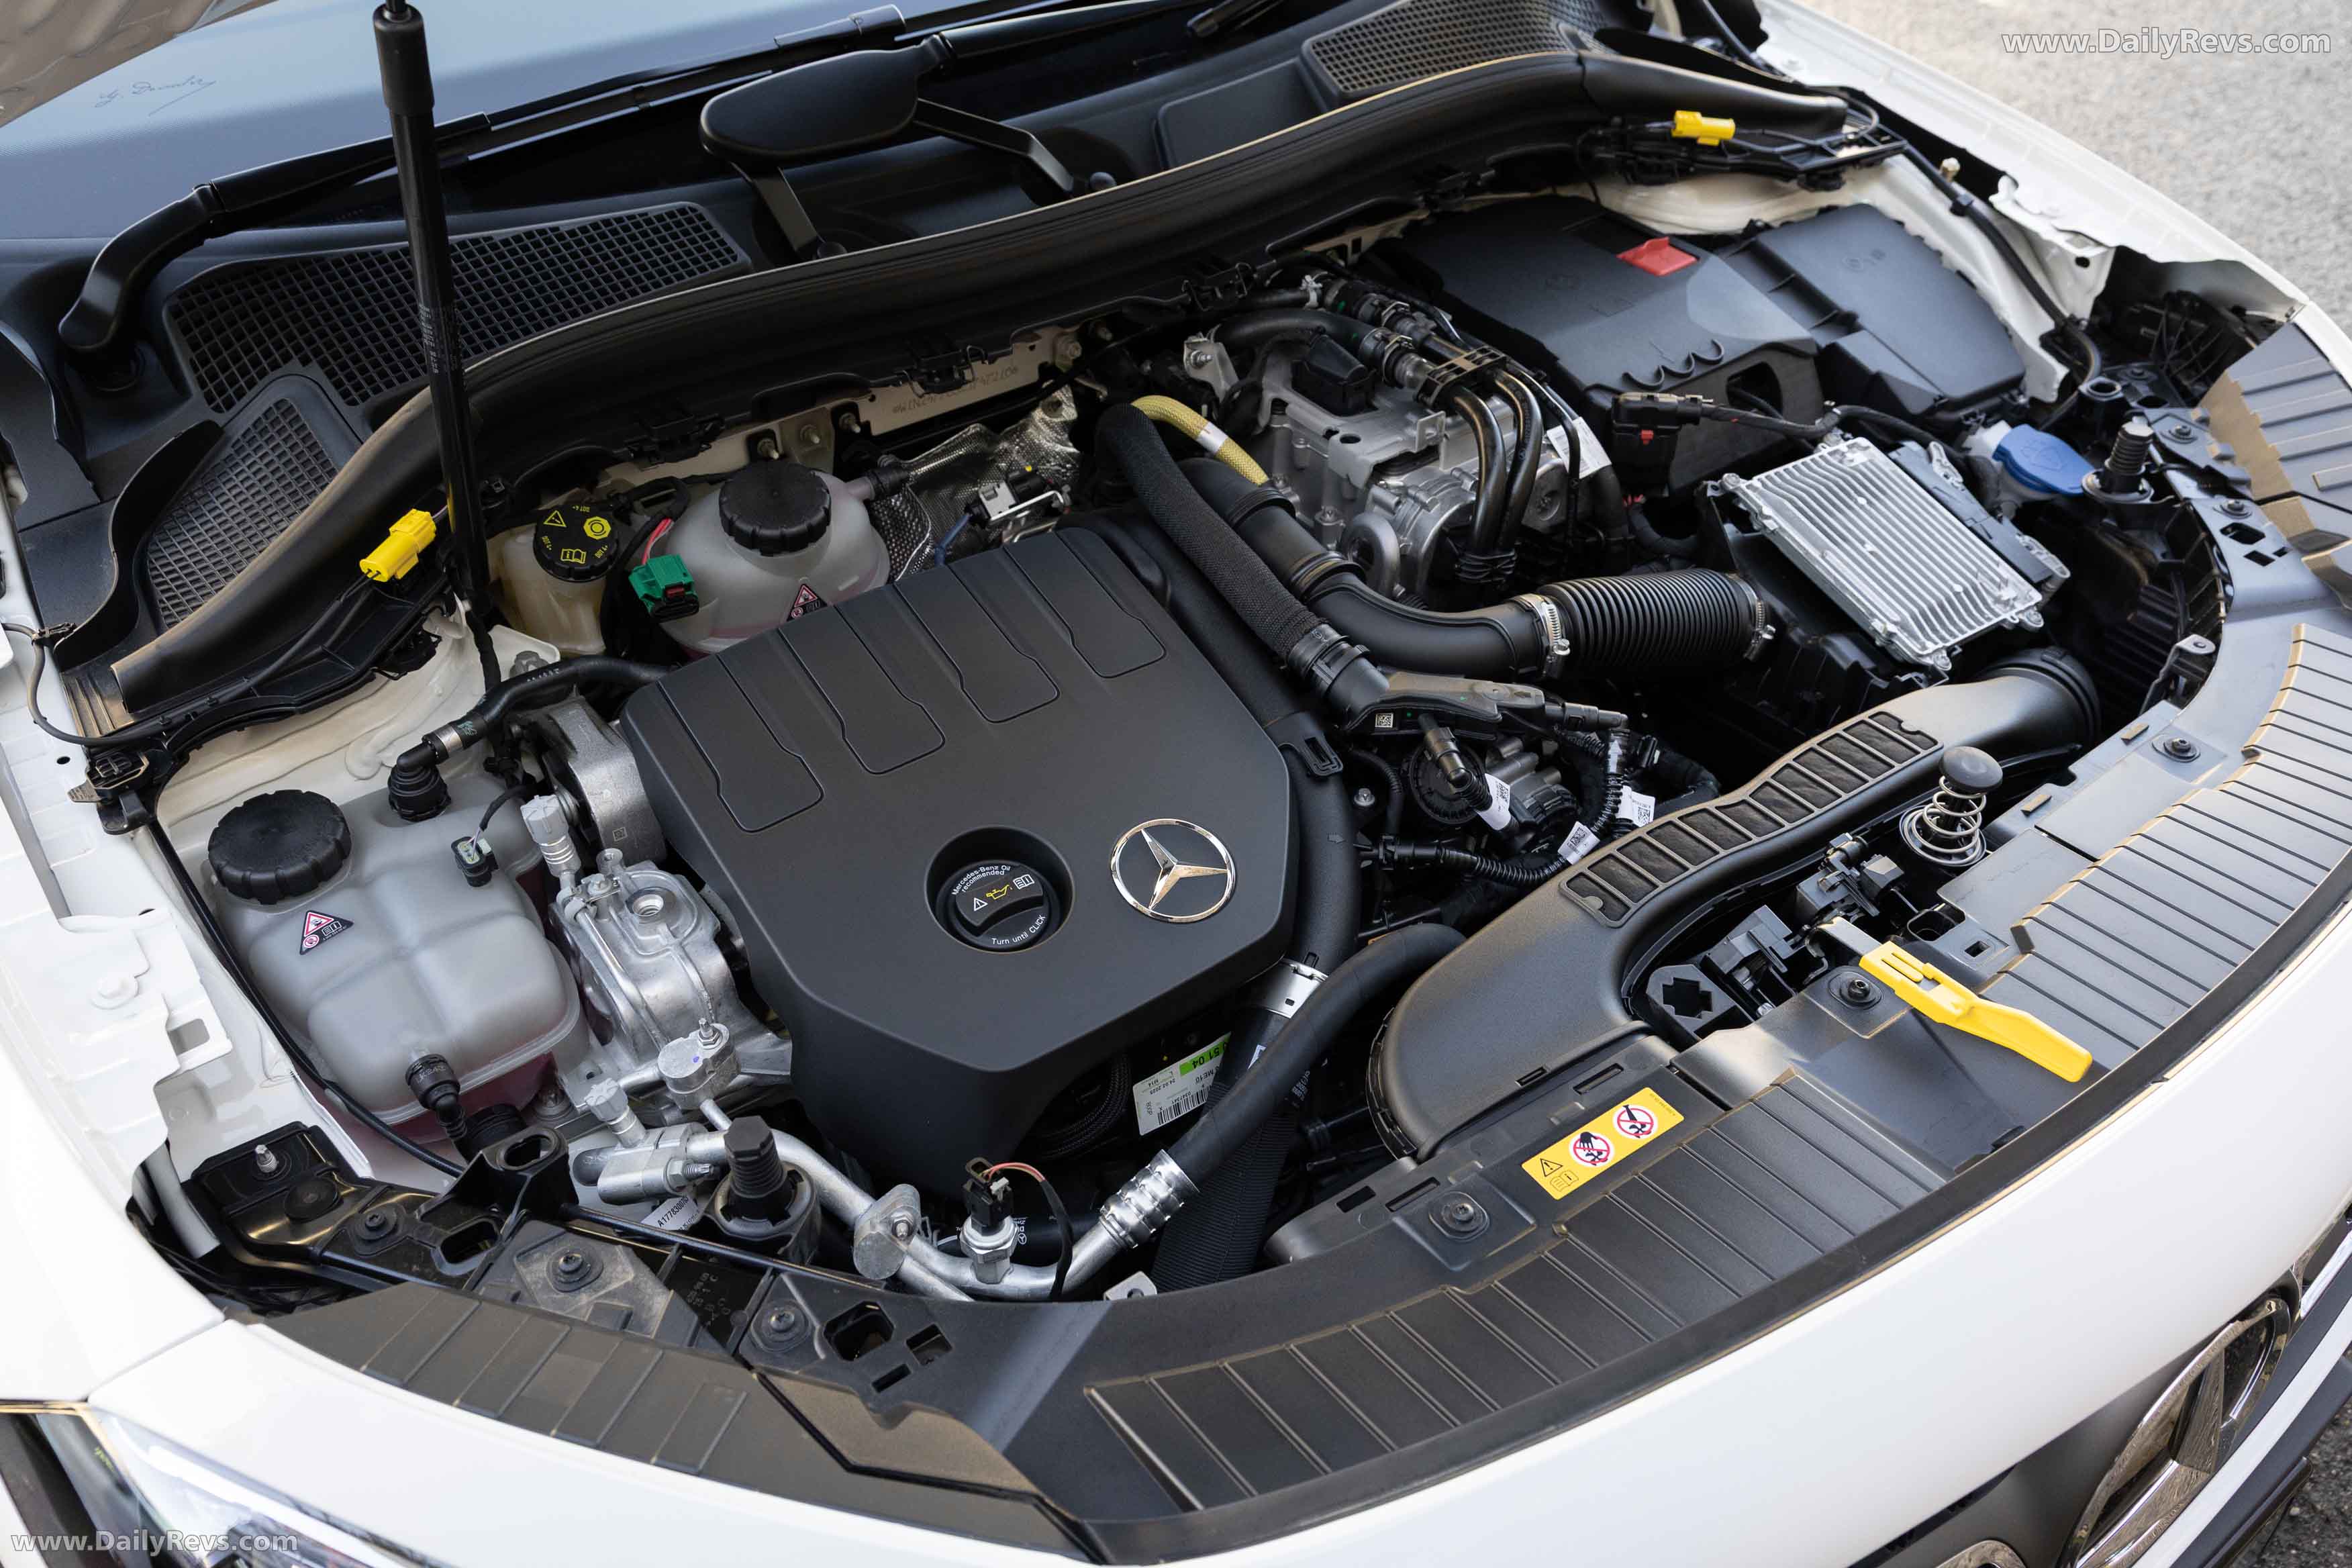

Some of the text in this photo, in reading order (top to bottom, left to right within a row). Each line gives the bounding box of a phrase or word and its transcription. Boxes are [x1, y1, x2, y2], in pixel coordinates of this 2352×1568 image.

[951, 865, 999, 895] Mercedes-Benz
[961, 869, 1005, 893] recommended
[991, 914, 1046, 945] Turn until CLICK
[1192, 1056, 1205, 1069] 04
